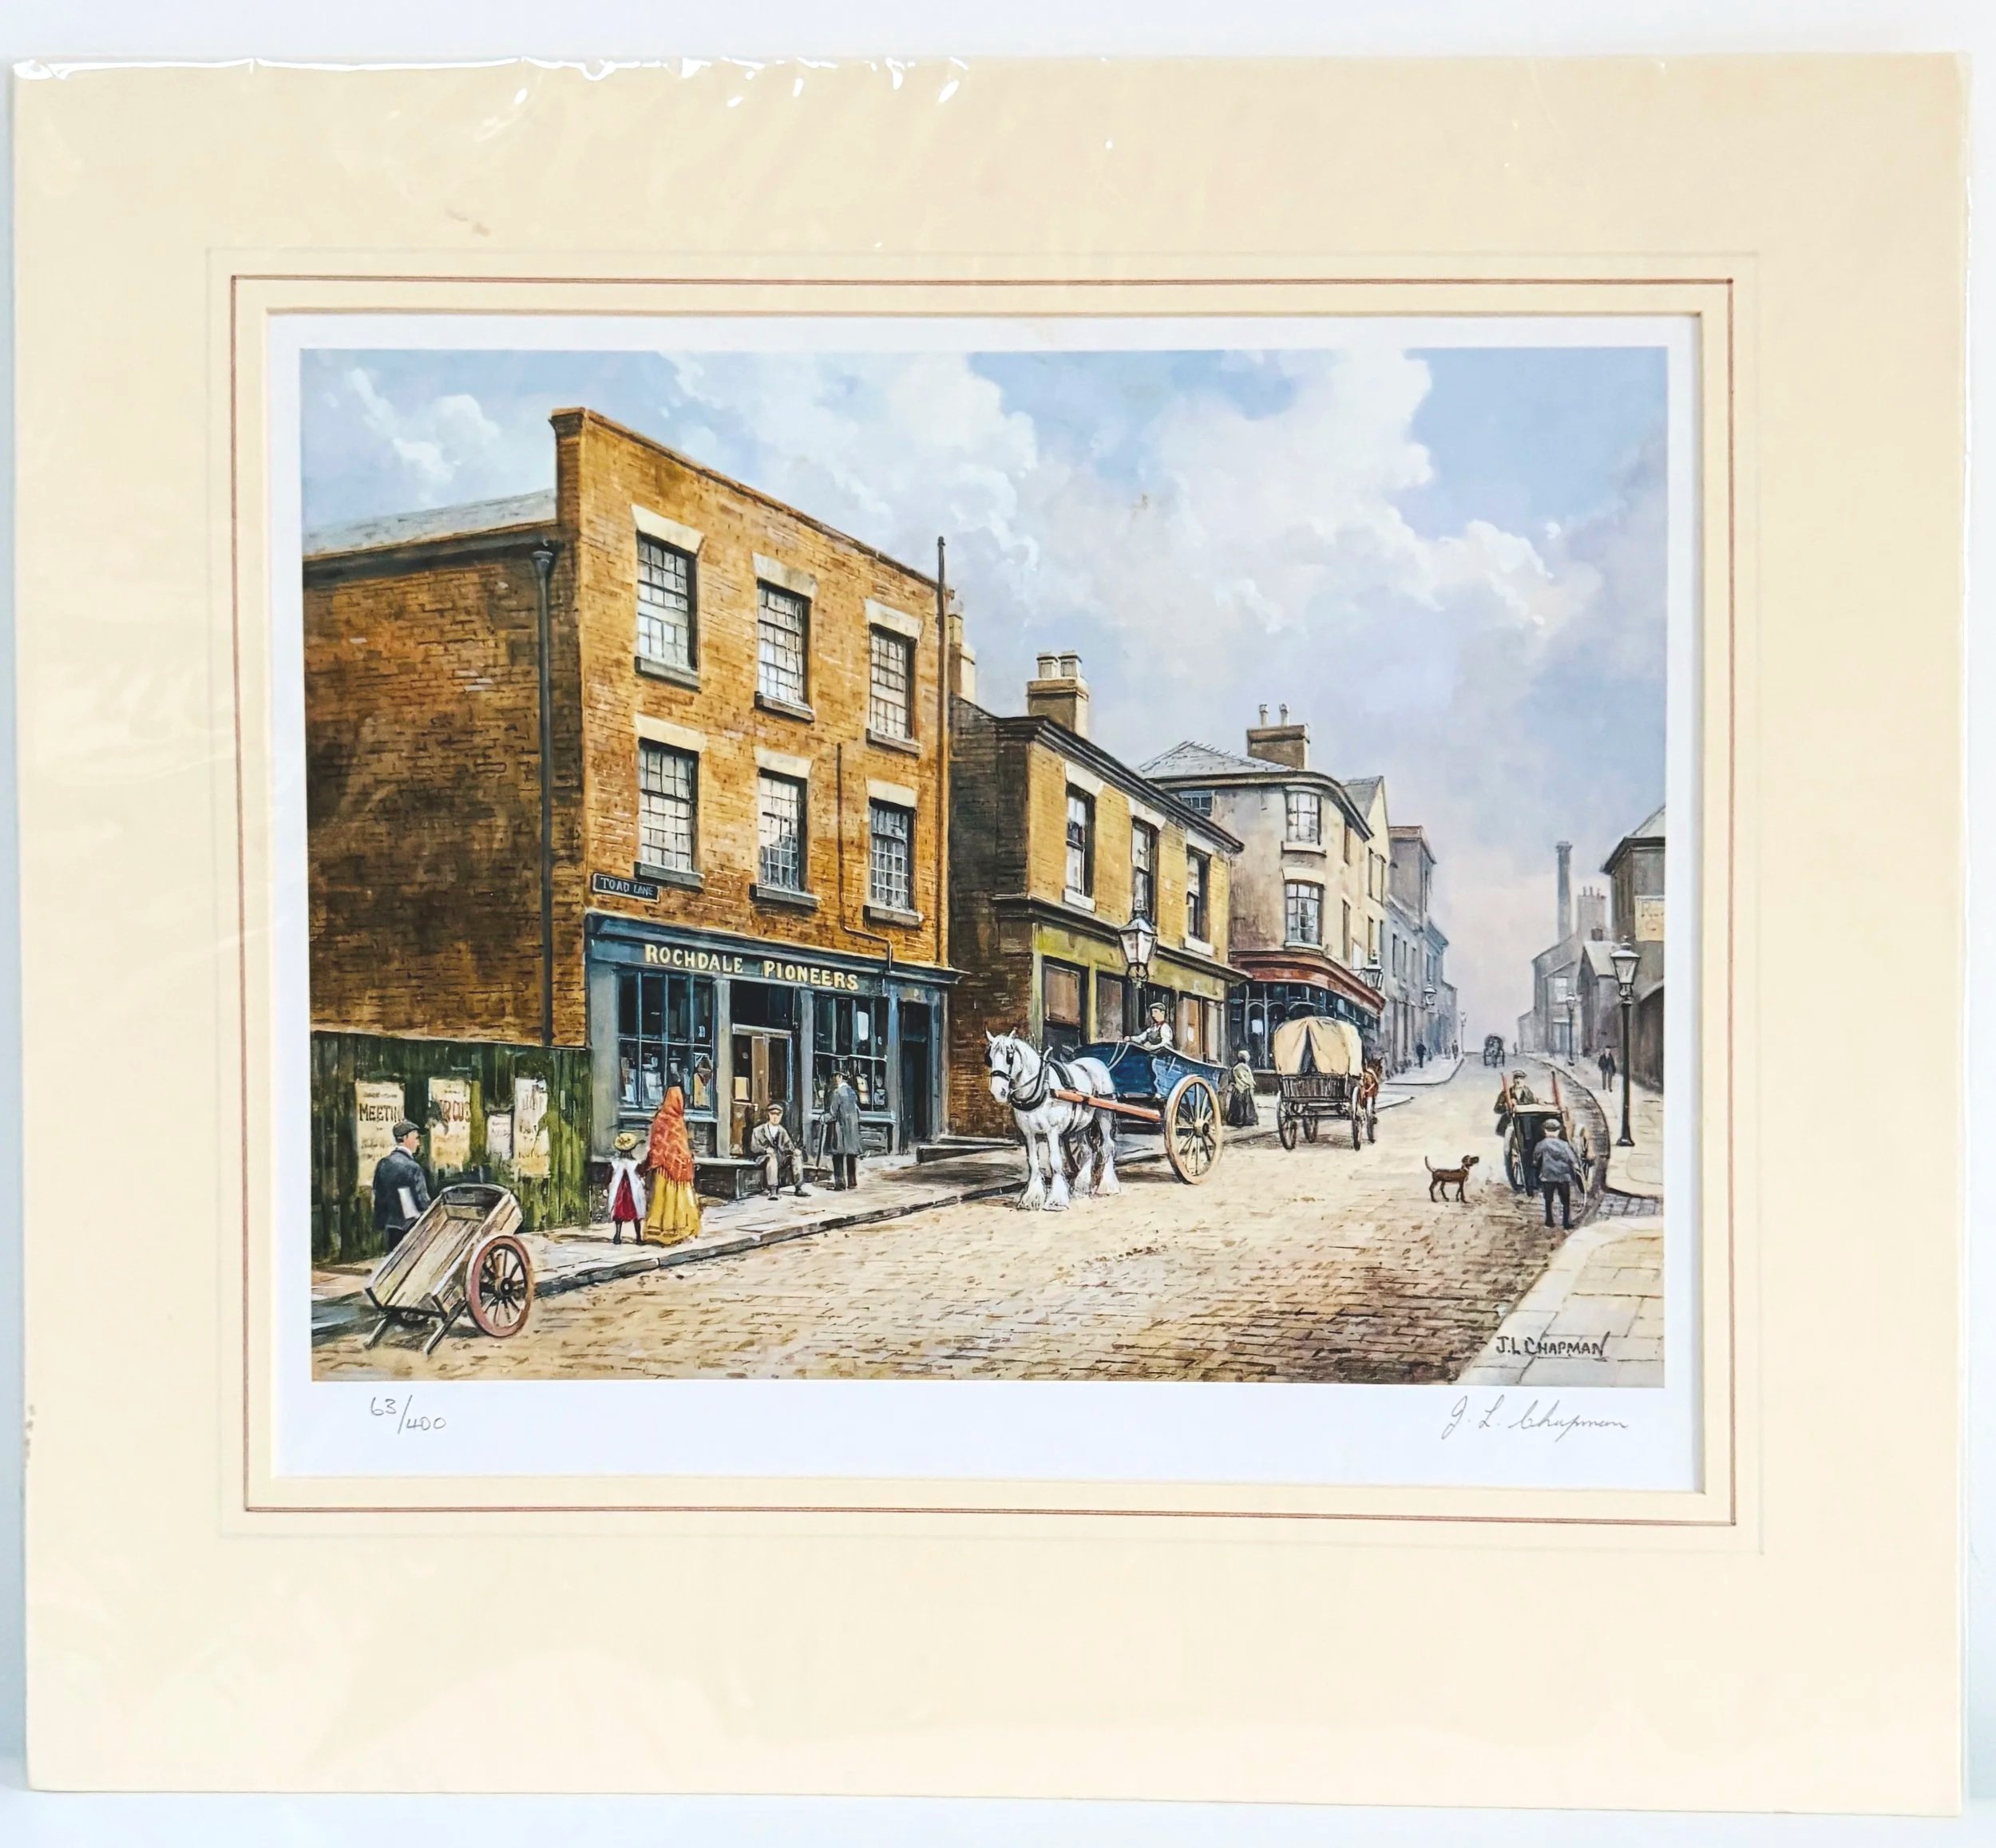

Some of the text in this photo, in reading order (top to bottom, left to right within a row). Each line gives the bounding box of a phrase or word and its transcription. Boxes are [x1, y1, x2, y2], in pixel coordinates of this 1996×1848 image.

[600, 877, 653, 896] TOAD LANE
[644, 944, 859, 991] ROCHDALE PIONEERS
[1523, 1331, 1610, 1357] CHAPMAN
[370, 1394, 447, 1435] 63/400
[1507, 1399, 1630, 1442] Chapman
